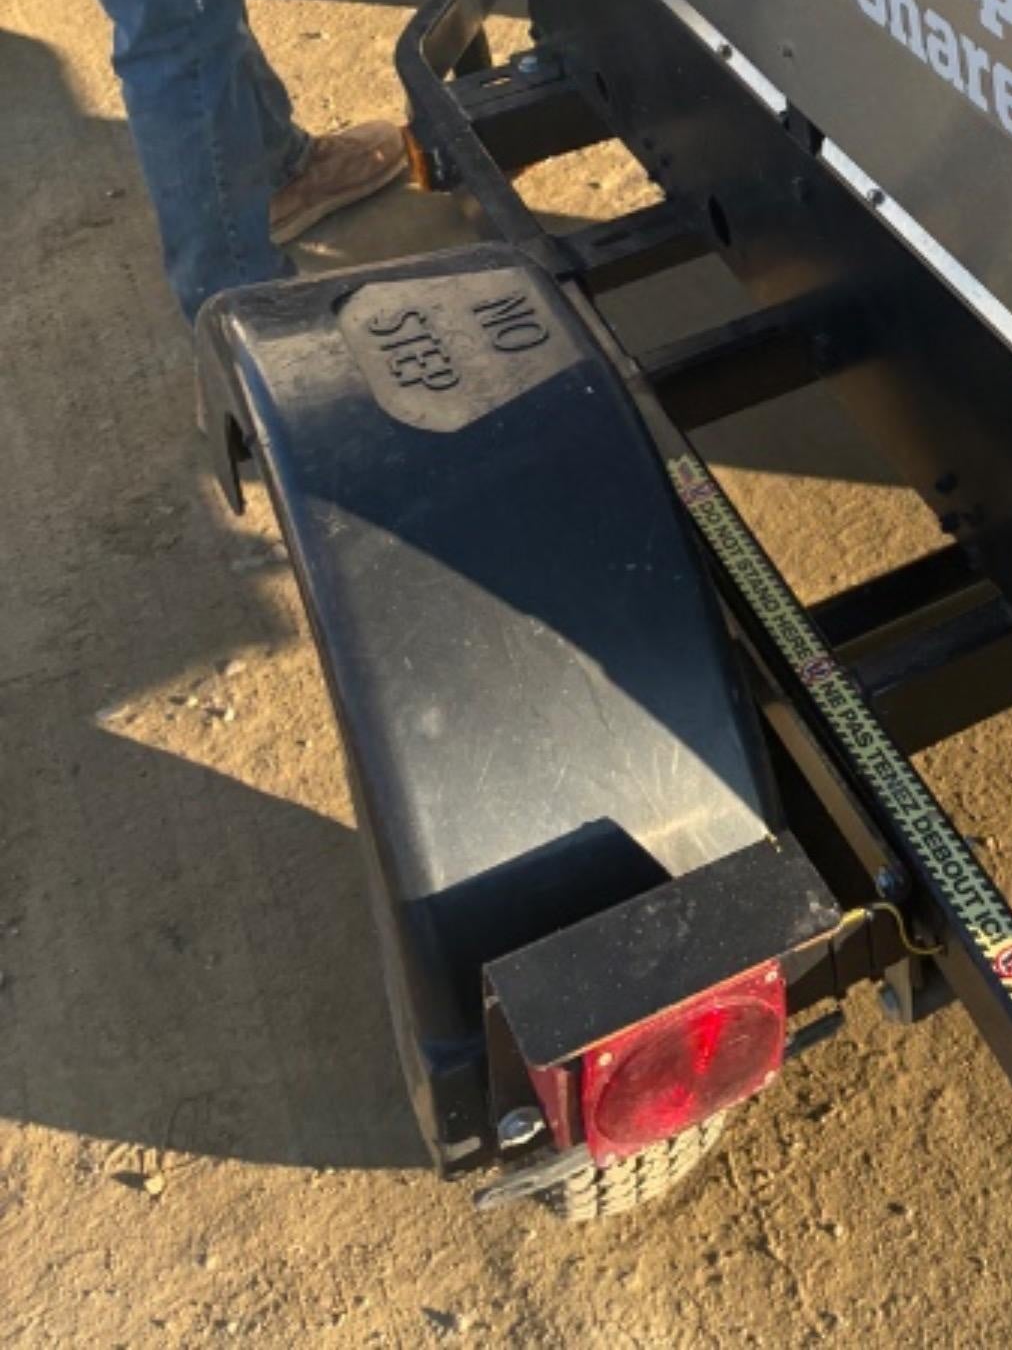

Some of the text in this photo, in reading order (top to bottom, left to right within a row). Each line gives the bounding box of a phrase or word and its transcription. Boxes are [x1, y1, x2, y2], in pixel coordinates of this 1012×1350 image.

[368, 310, 460, 391] STEP
[473, 295, 550, 352] NO
[702, 502, 722, 524] DO
[716, 525, 745, 556] NOT
[736, 558, 781, 612] STAND
[772, 612, 813, 661] HERE
[838, 700, 874, 749] PAS
[867, 744, 922, 815] TENEZ
[911, 810, 985, 908] DEBOUT
